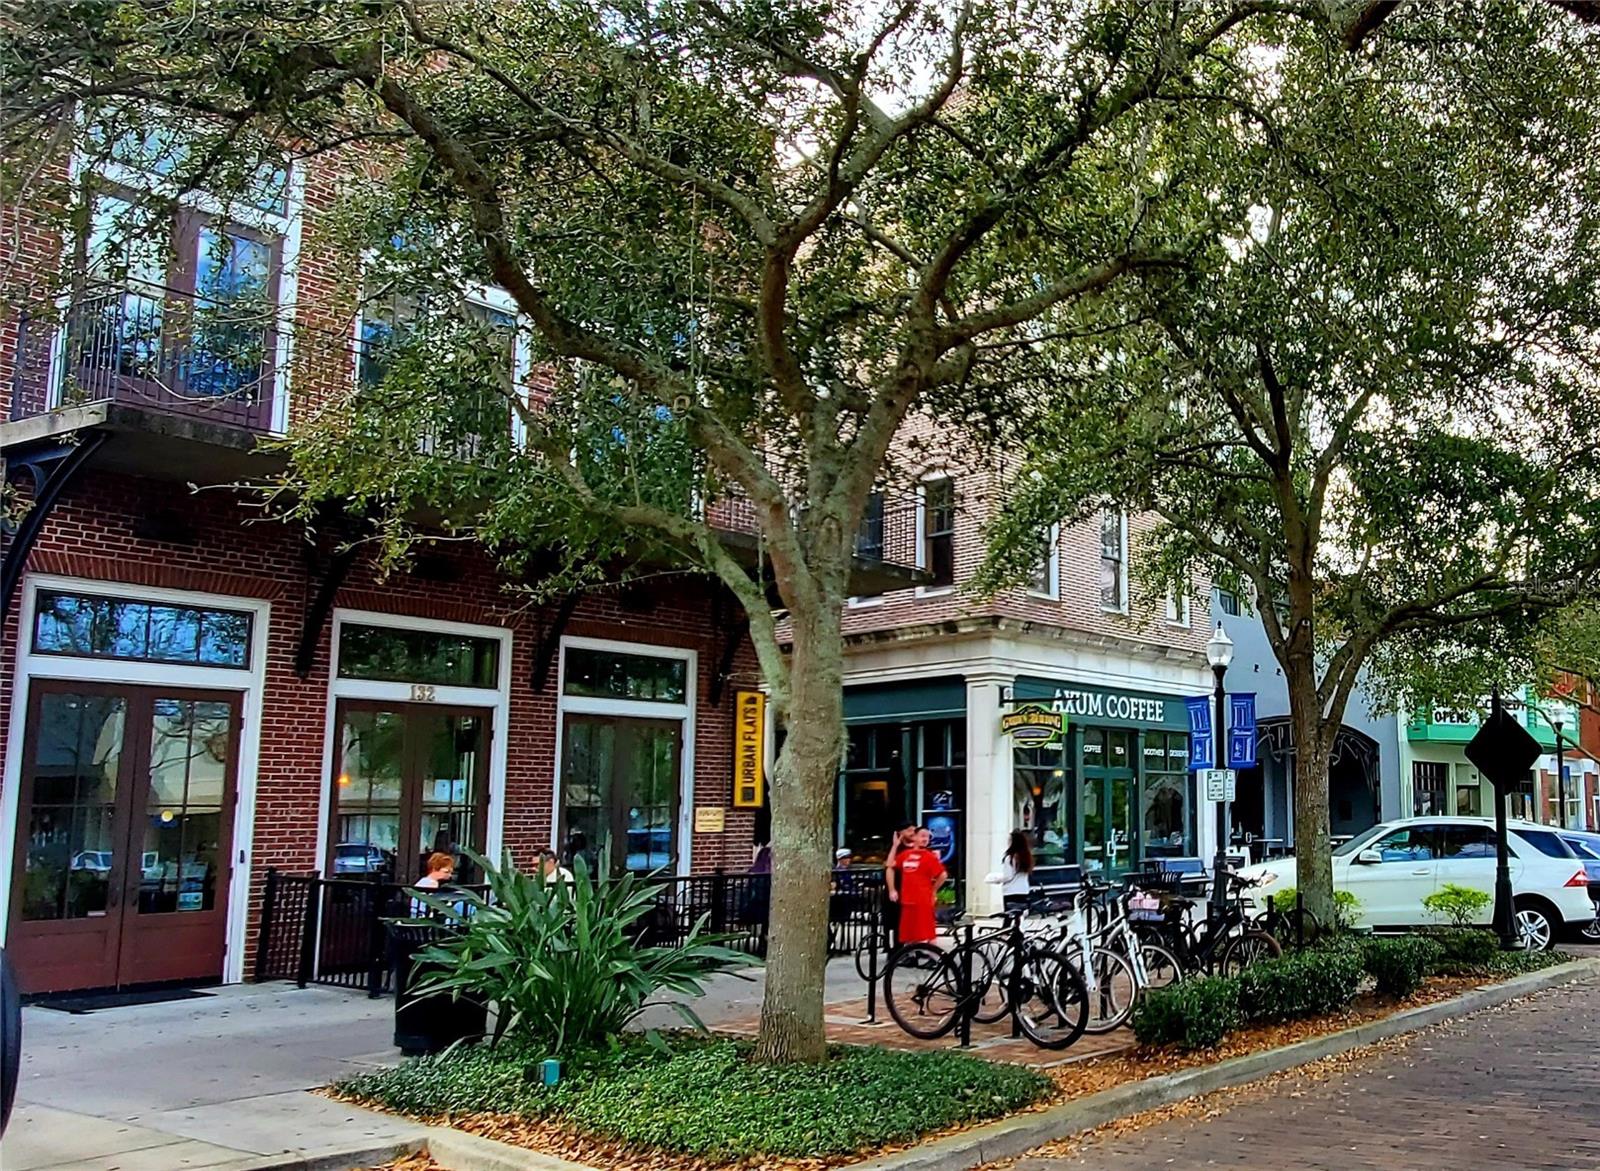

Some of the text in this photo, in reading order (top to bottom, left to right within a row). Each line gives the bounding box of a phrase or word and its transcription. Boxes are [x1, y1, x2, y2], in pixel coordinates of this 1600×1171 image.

[411, 685, 435, 701] 132
[1051, 689, 1164, 722] AXUM COFFEE
[742, 707, 757, 784] URBAN FLATS
[1083, 744, 1102, 753] COFFEE
